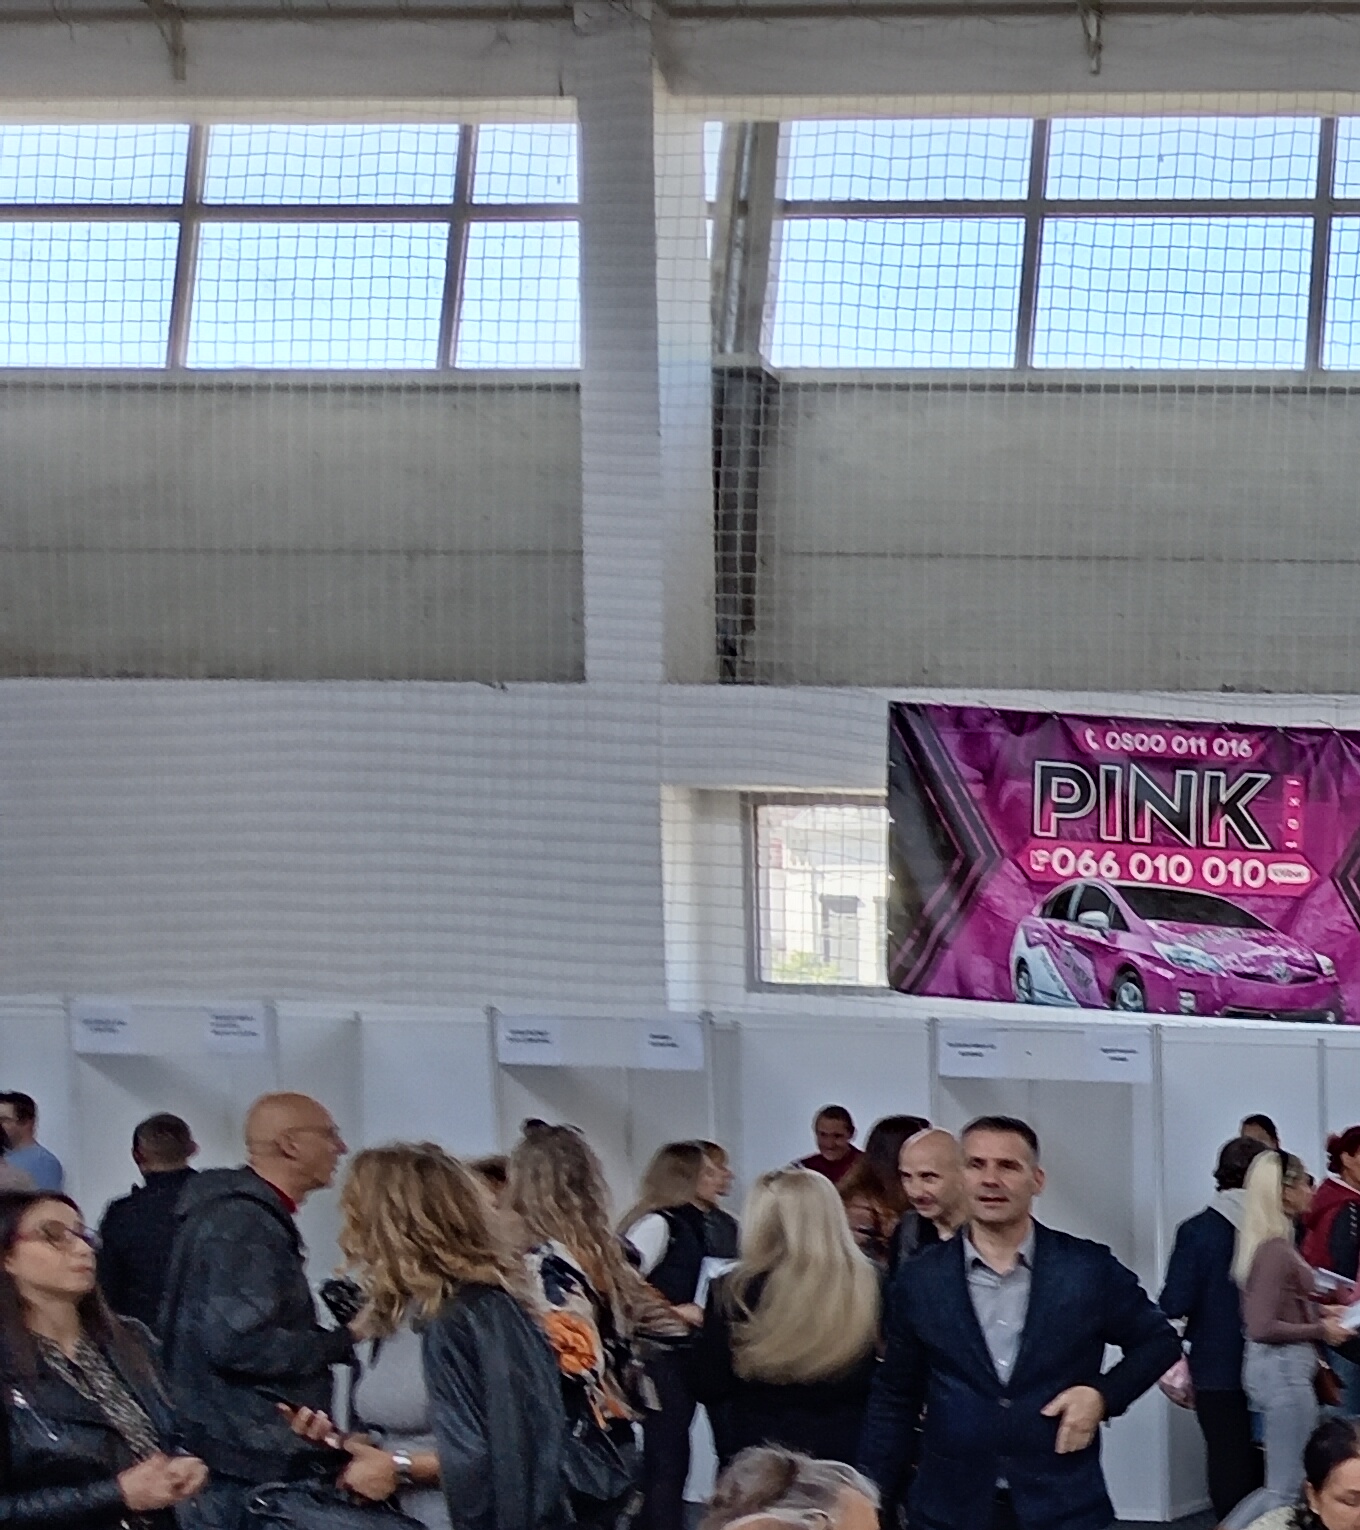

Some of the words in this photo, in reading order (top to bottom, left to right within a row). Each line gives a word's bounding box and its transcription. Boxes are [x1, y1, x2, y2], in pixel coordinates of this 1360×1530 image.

[1032, 760, 1272, 850] PINK
[1051, 847, 1120, 879] 066
[1128, 852, 1193, 884] 010
[1201, 856, 1266, 888] 010
